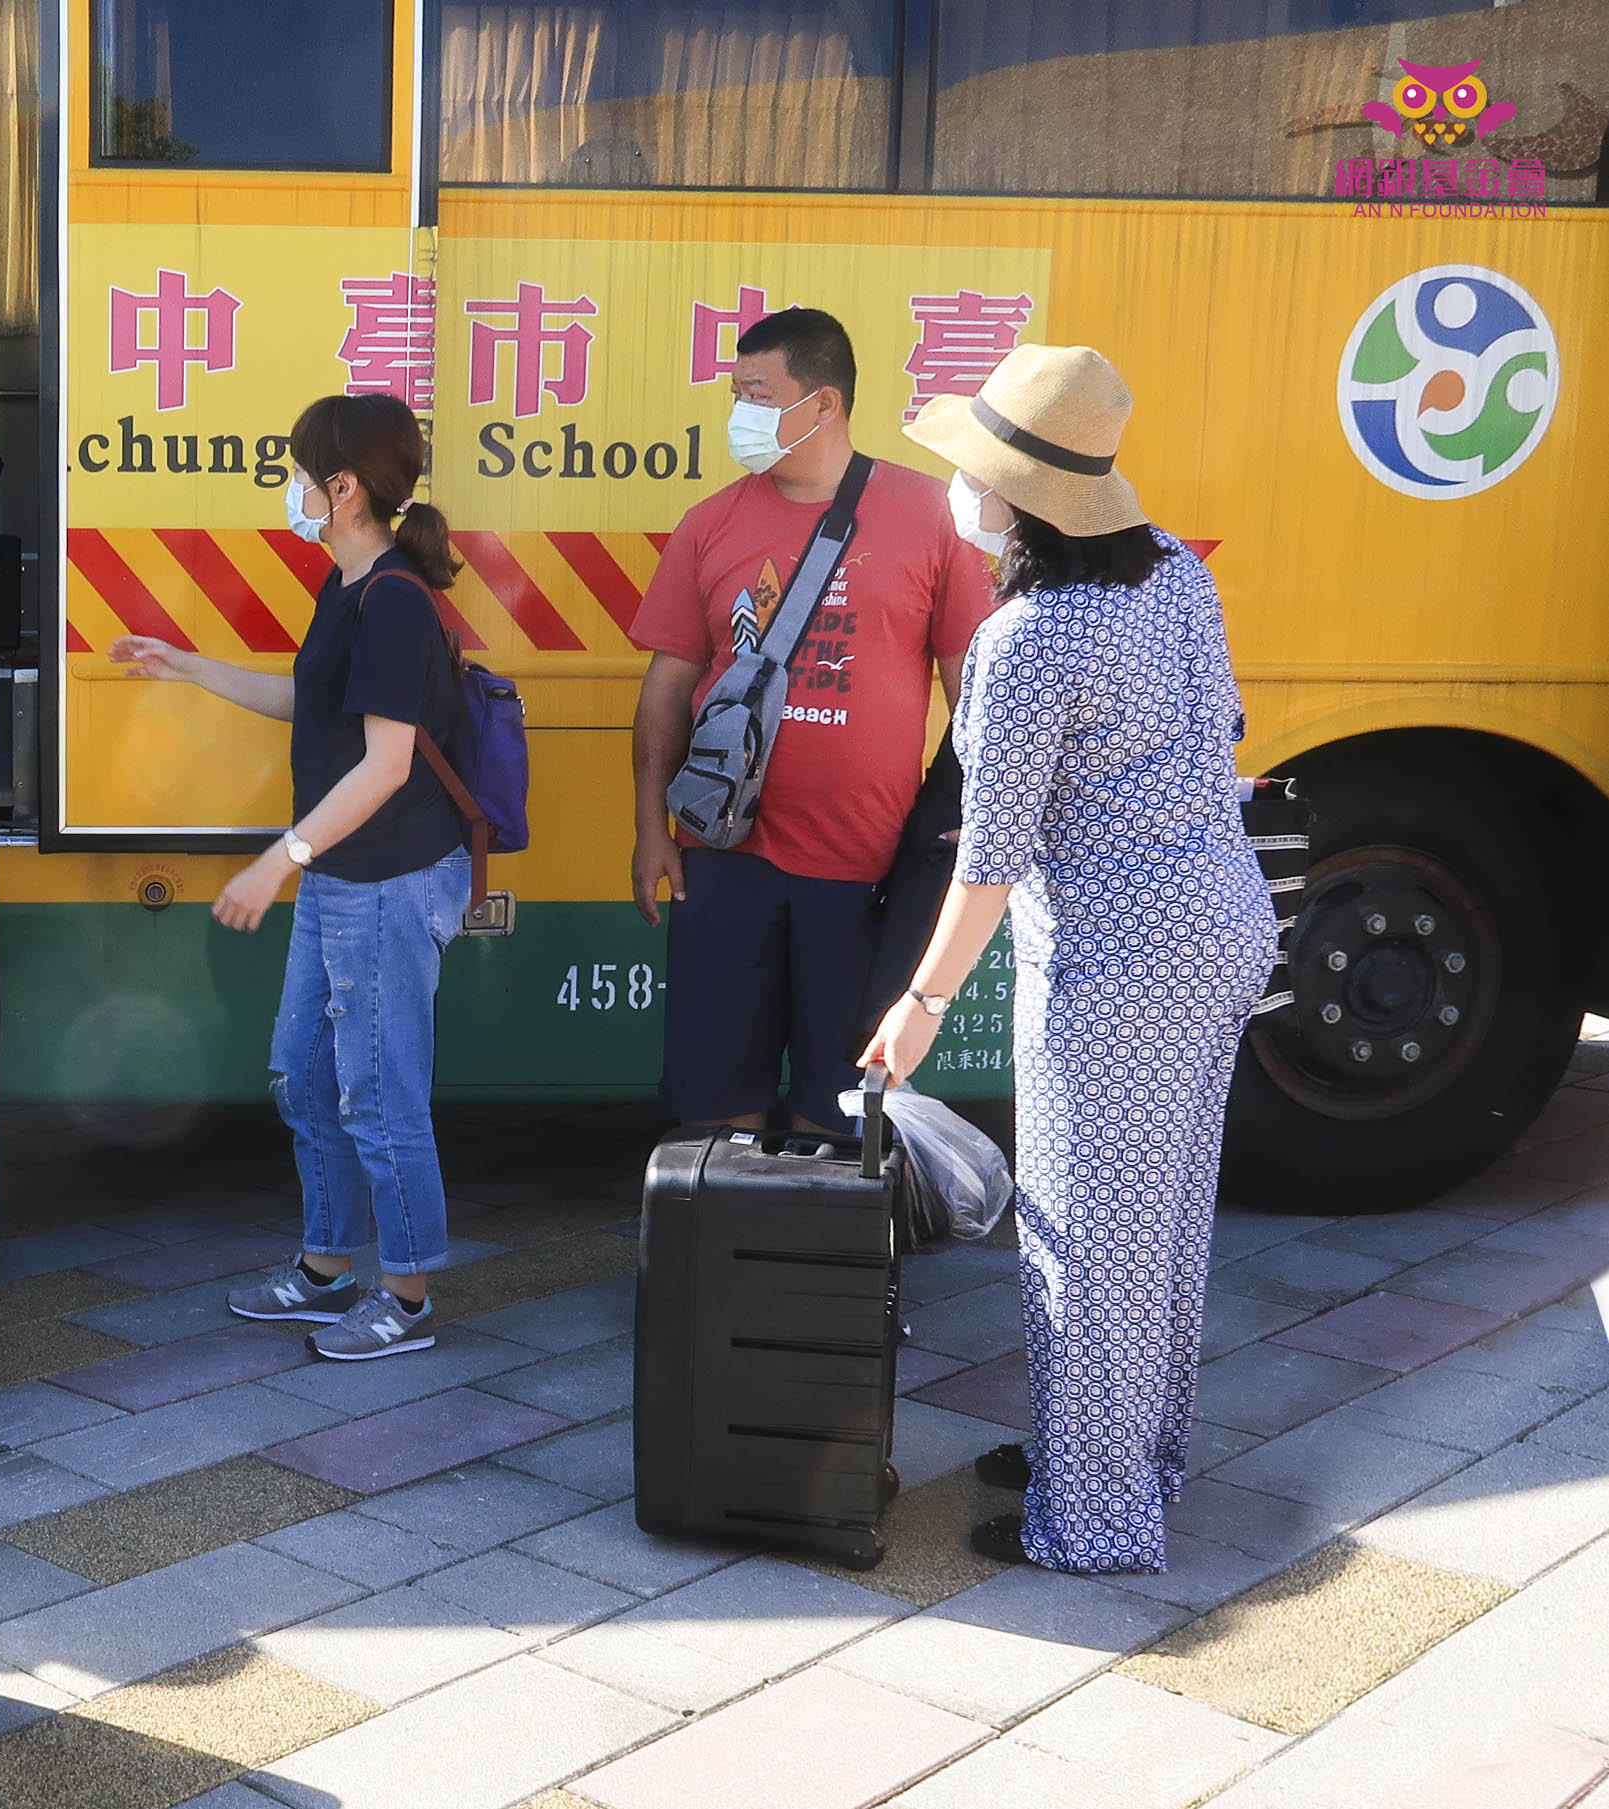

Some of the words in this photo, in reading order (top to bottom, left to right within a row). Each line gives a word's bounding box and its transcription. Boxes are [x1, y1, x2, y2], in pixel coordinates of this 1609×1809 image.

[67, 415, 291, 489] chung
[478, 421, 703, 480] School
[272, 1281, 307, 1308] N
[370, 1315, 405, 1344] N
